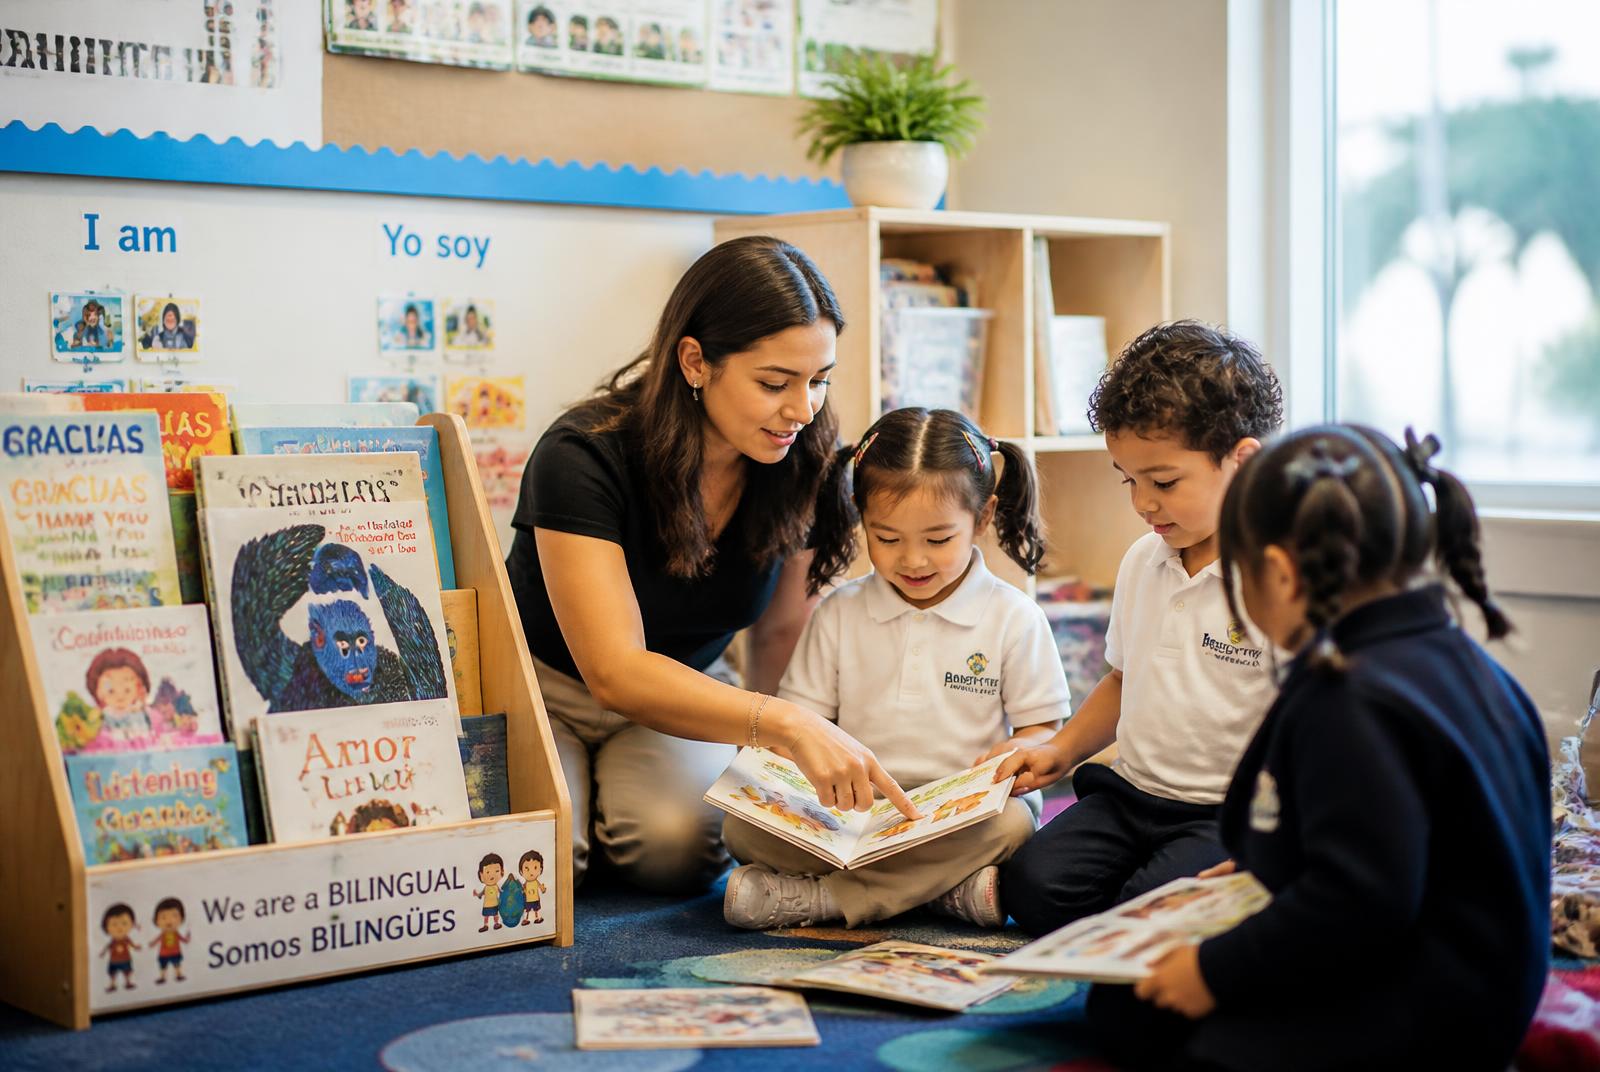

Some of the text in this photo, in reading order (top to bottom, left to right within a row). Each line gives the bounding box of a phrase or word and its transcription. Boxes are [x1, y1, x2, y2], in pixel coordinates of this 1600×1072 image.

[83, 213, 177, 253] I am
[382, 223, 491, 269] Yo soy
[202, 866, 466, 925] We are a BILINGUAL
[207, 936, 302, 970] Somos
